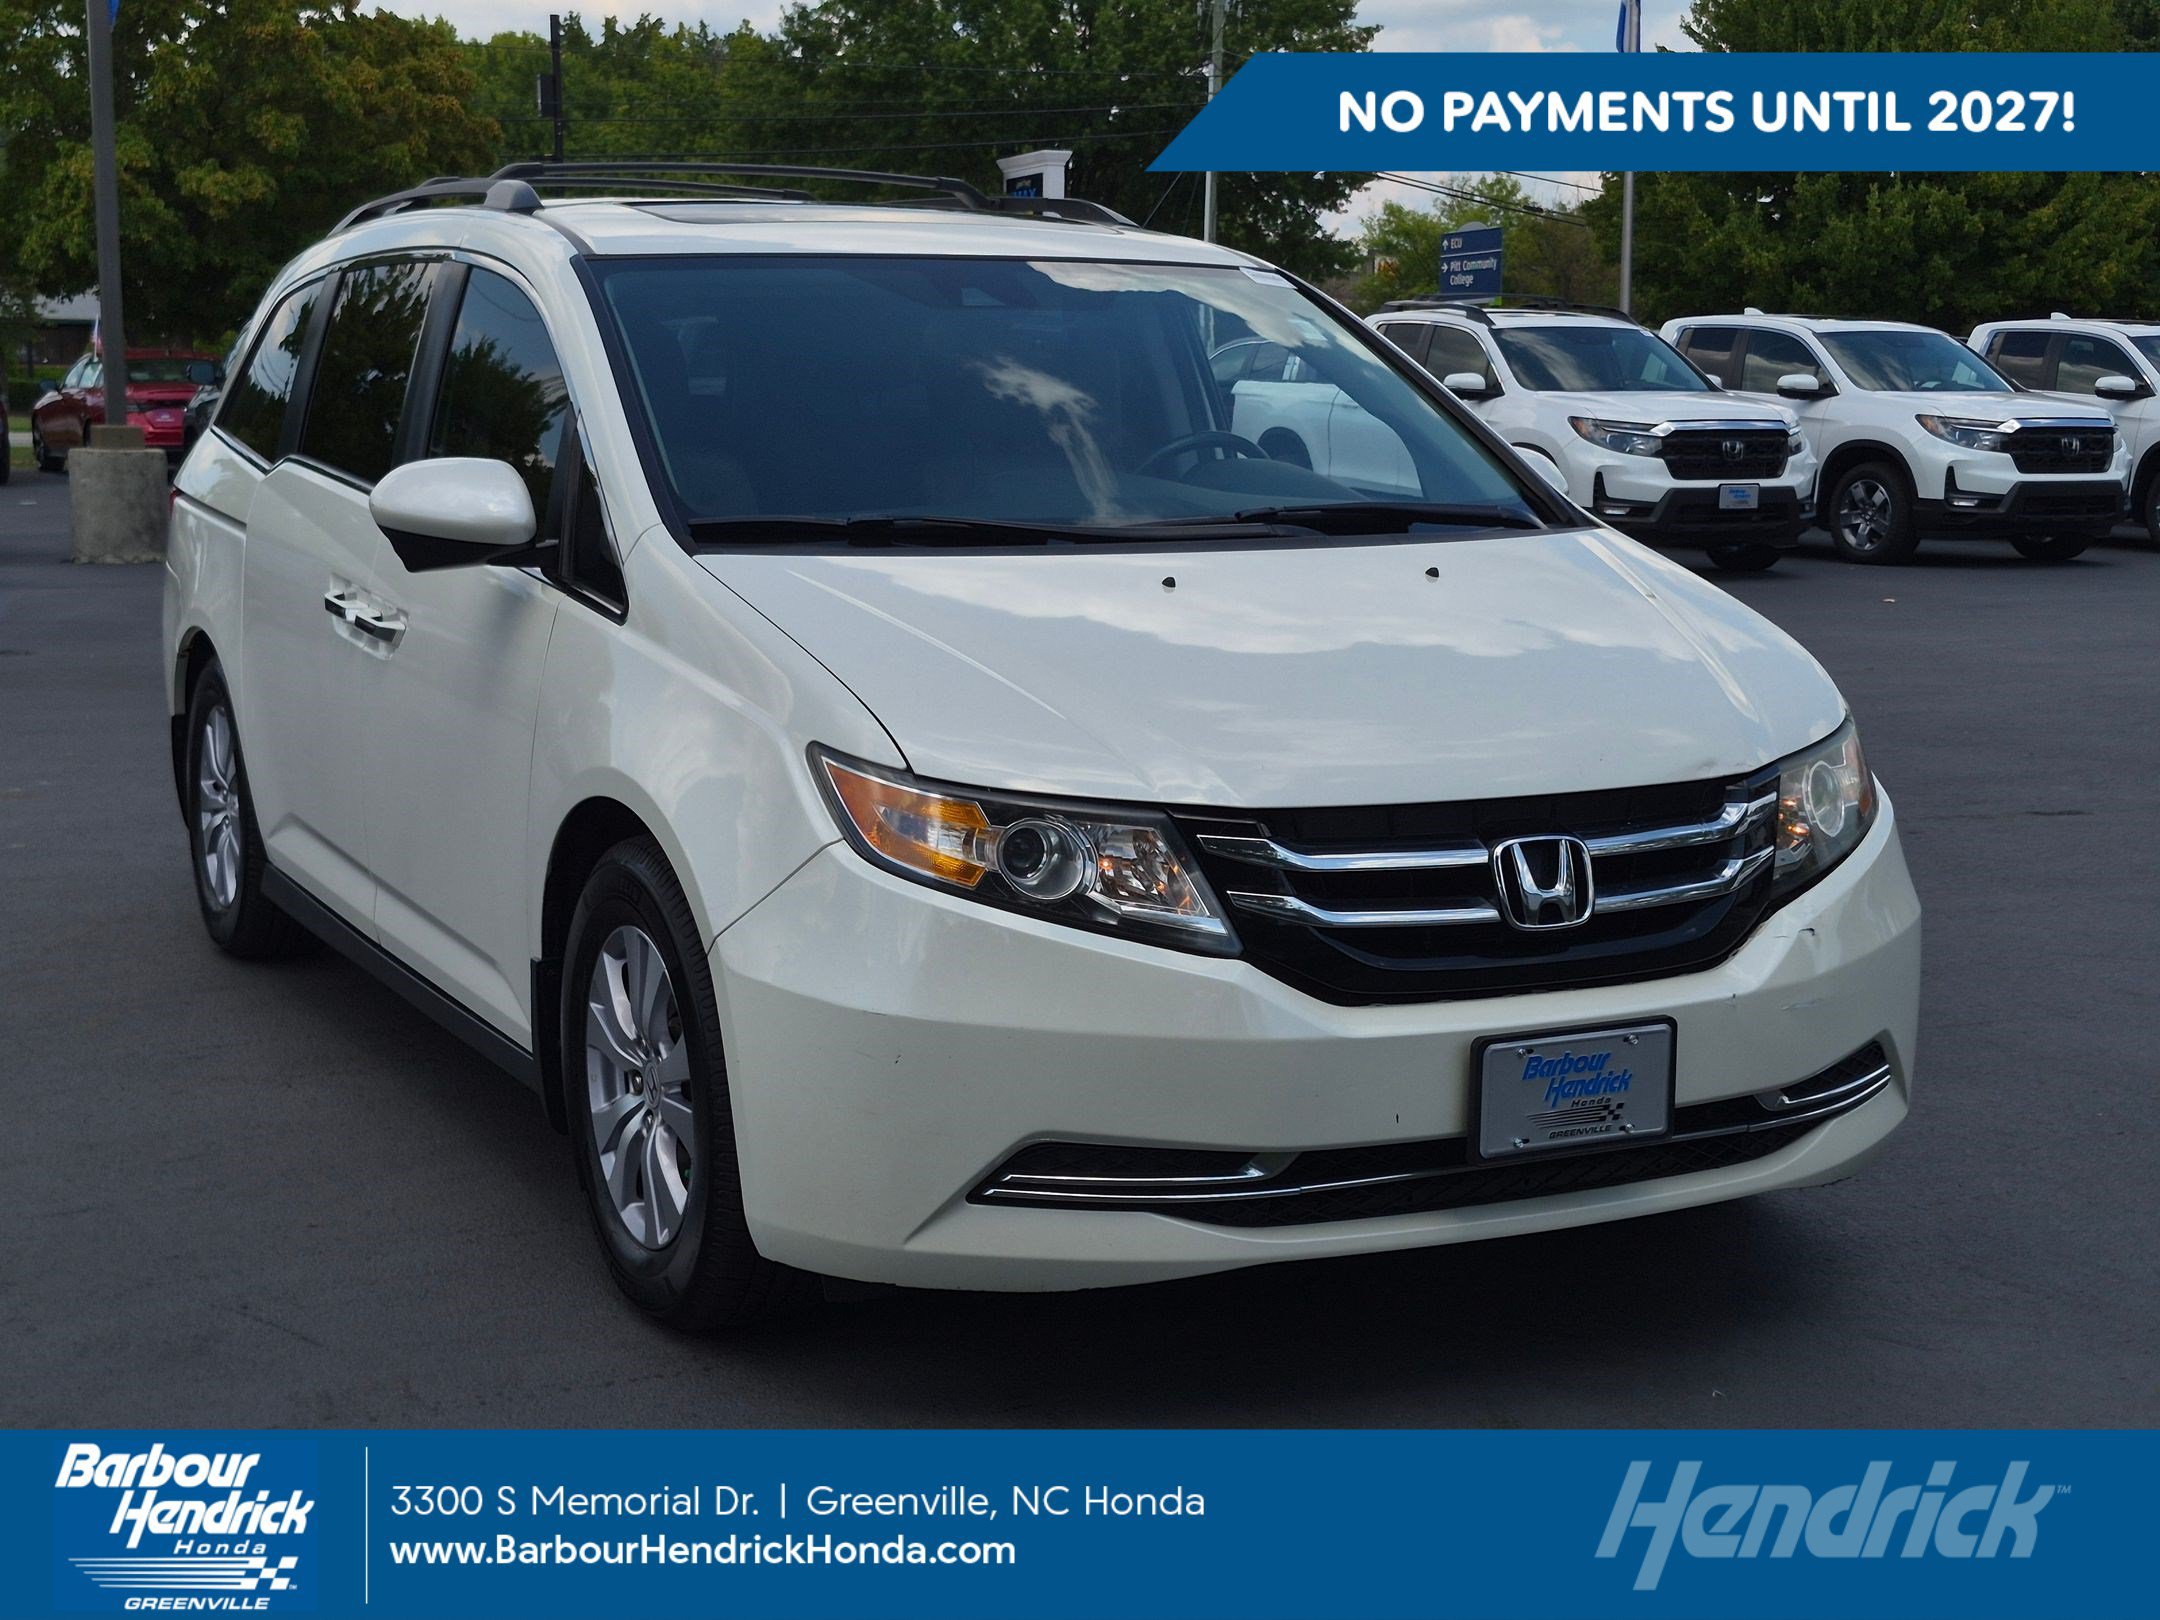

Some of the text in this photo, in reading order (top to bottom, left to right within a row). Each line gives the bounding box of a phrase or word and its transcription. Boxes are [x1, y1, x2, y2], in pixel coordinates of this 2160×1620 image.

[1450, 238, 1463, 249] ECU
[1450, 257, 1498, 272] Pitt Community
[1449, 273, 1474, 287] College
[1522, 1051, 1613, 1081] Barbour
[1544, 1069, 1633, 1108] Hendrick
[1571, 1096, 1612, 1108] Honda
[1549, 1124, 1613, 1139] GREENVILLE
